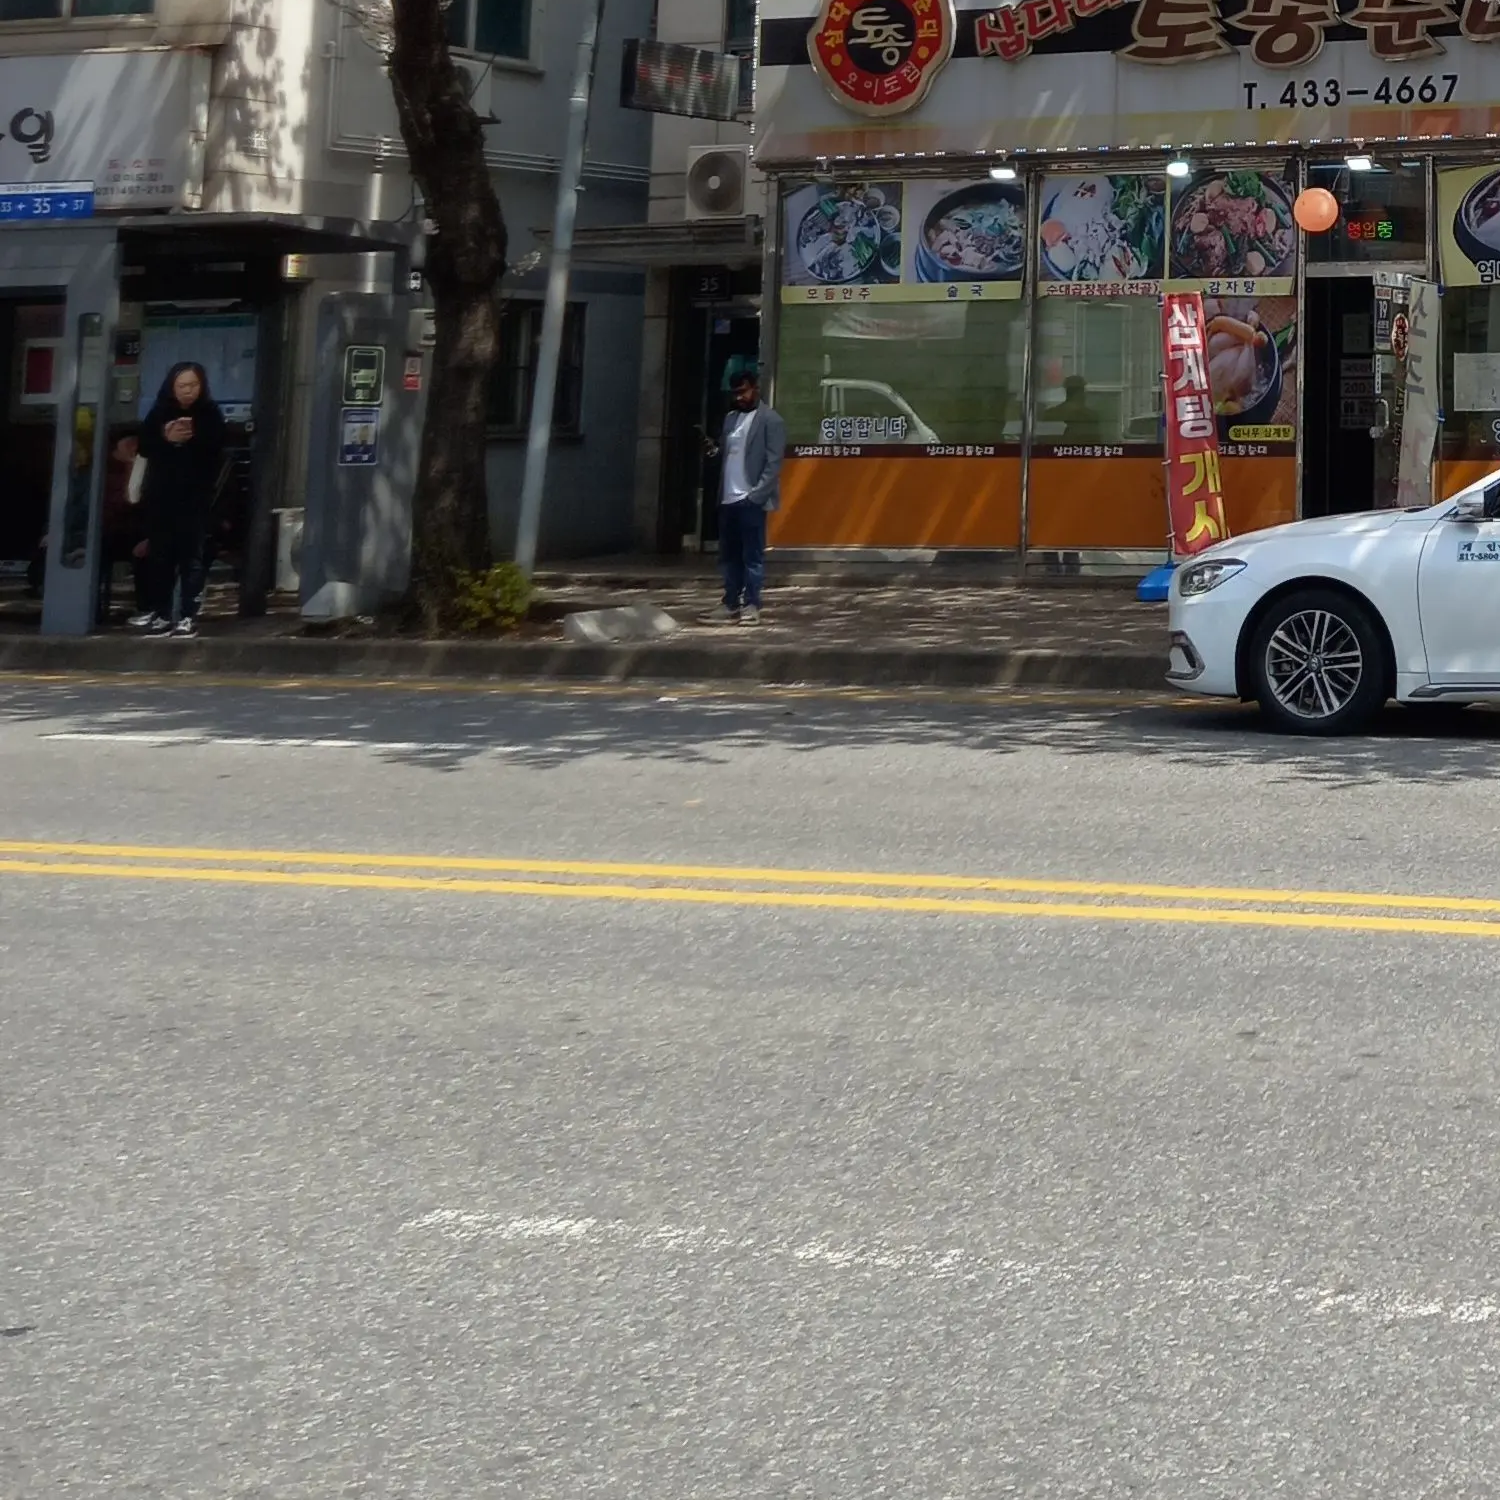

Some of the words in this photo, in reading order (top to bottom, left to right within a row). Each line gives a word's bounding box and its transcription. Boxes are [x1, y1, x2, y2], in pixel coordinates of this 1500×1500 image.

[840, 60, 922, 98] 오이도점
[1279, 74, 1459, 108] 433-4667
[32, 198, 51, 214] 35
[73, 199, 85, 211] 37
[1347, 221, 1393, 239] 영업중
[700, 277, 718, 292] 35
[807, 288, 871, 300] 모듬안주
[1209, 280, 1256, 295] 감자탕
[1168, 303, 1214, 438] 삼계탕
[821, 416, 907, 439] 영업합니다
[1180, 450, 1228, 542] 개시
